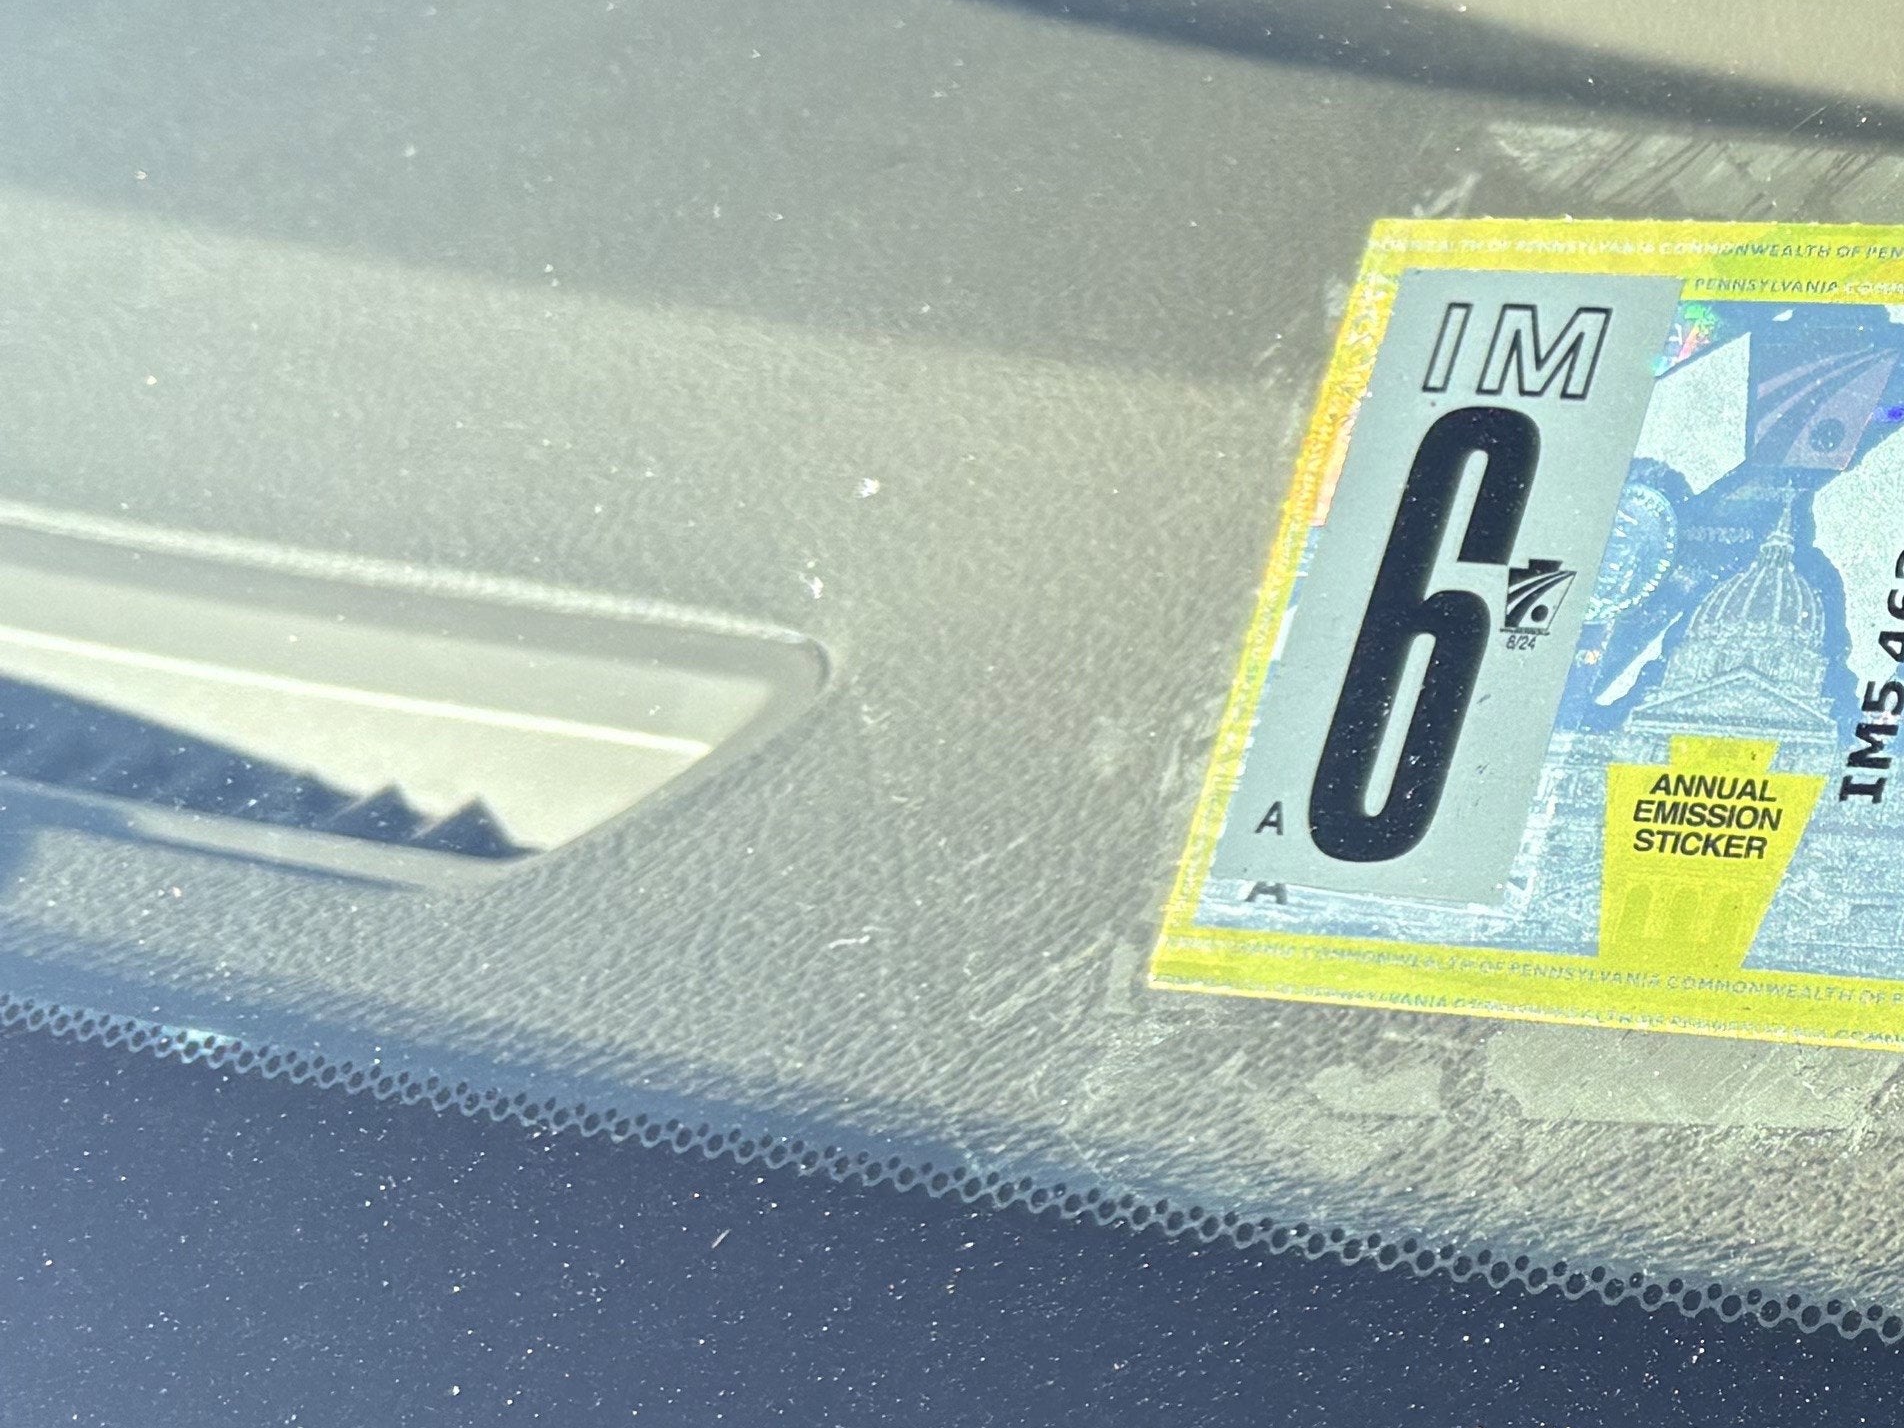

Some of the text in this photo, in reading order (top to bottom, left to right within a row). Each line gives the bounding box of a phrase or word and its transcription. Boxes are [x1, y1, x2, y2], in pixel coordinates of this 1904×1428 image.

[1422, 302, 1614, 401] IM
[1308, 405, 1541, 863] 6
[1649, 773, 1778, 803] ANNUAL
[1254, 800, 1285, 836] A
[1633, 799, 1783, 831] EMISSION
[1633, 828, 1767, 860] STICKER
